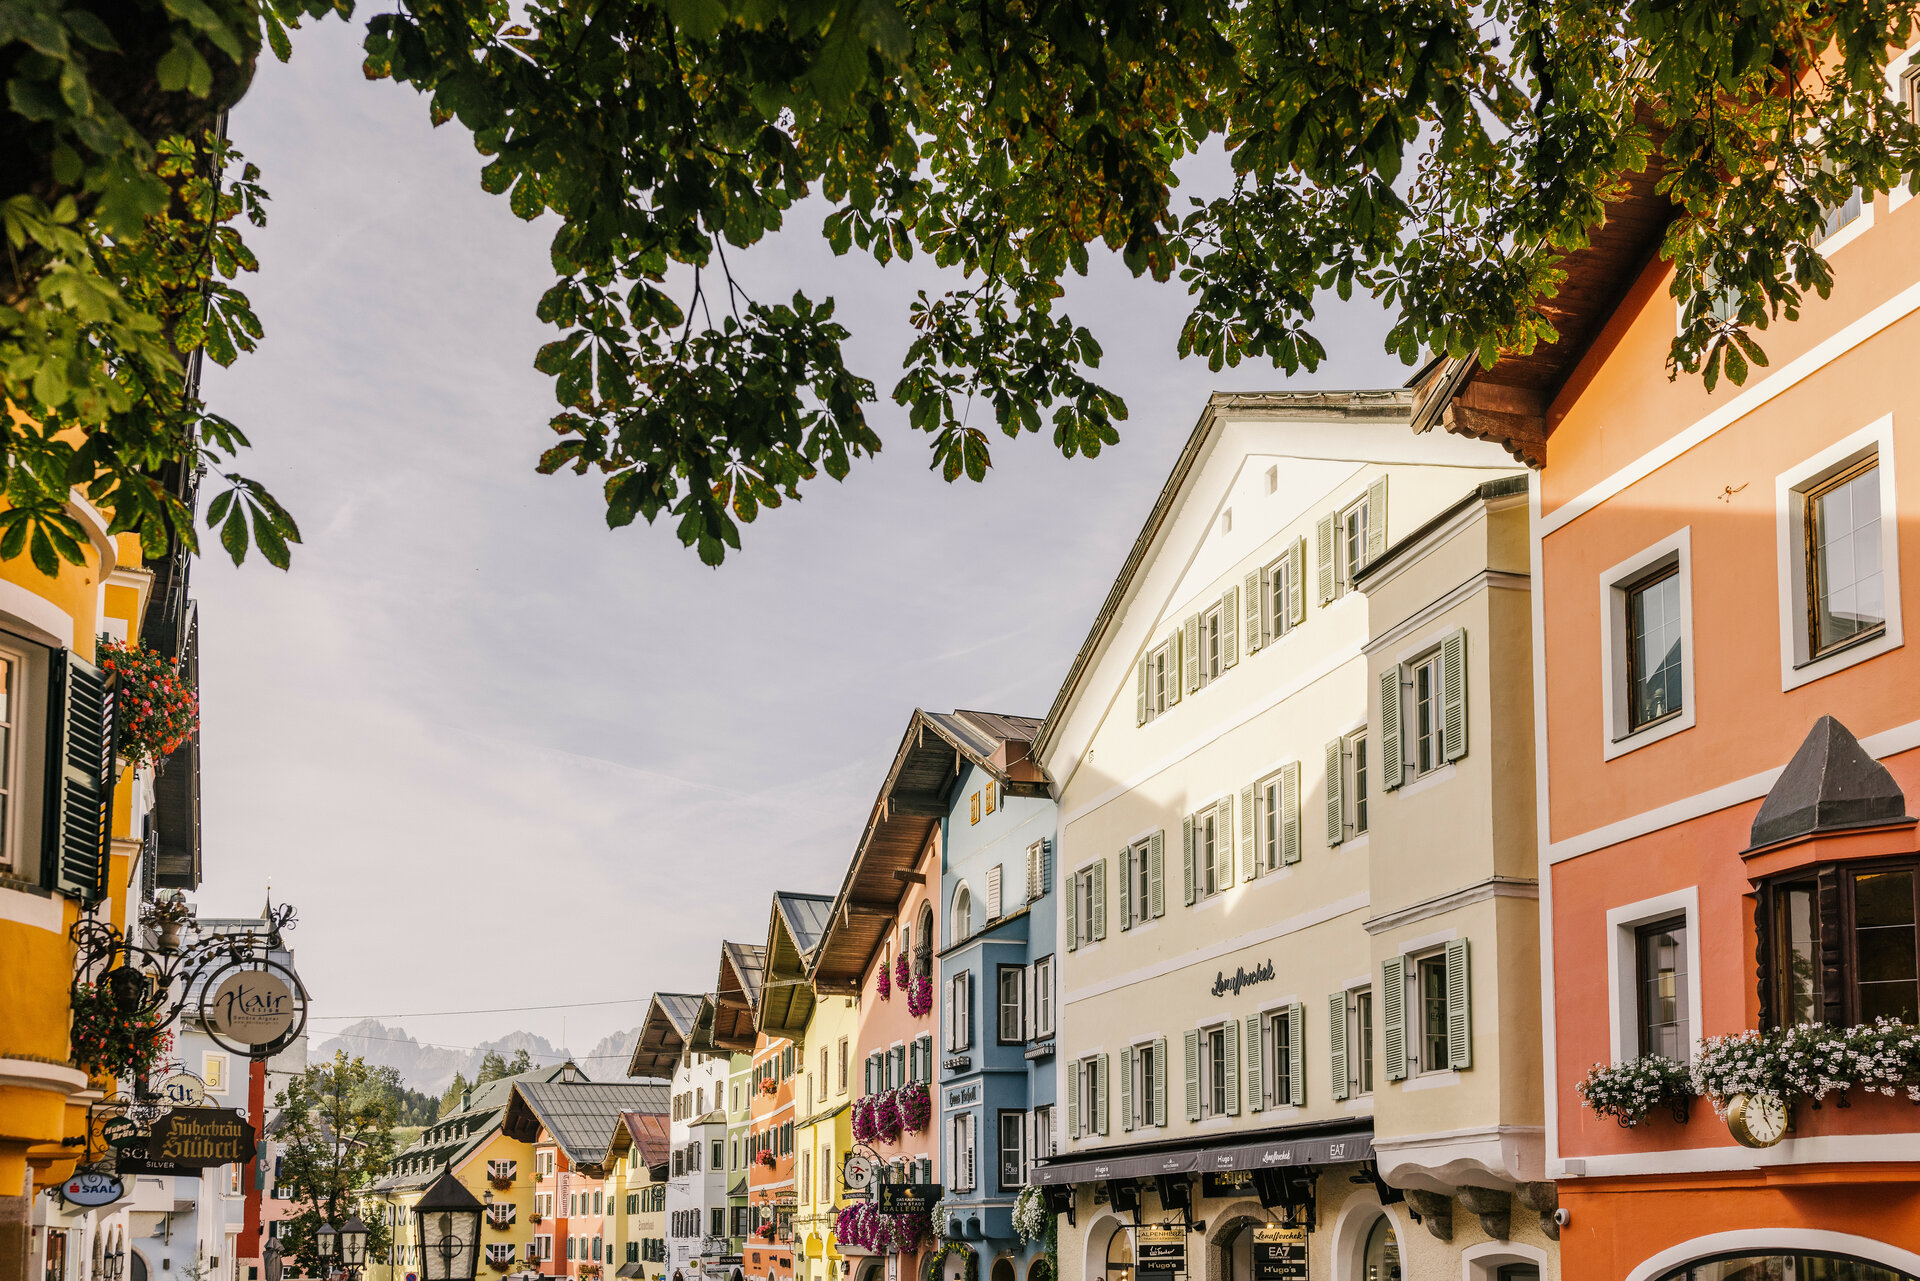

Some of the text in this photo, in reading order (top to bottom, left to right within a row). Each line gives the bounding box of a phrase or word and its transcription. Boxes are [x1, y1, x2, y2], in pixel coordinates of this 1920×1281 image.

[216, 984, 290, 1028] Hair
[104, 1123, 132, 1135] Huber
[111, 1129, 135, 1142] Bräu
[1330, 1143, 1345, 1156] EA7
[146, 1160, 175, 1169] SILVER
[82, 1184, 116, 1194] SAAL
[1268, 1246, 1290, 1257] EA7
